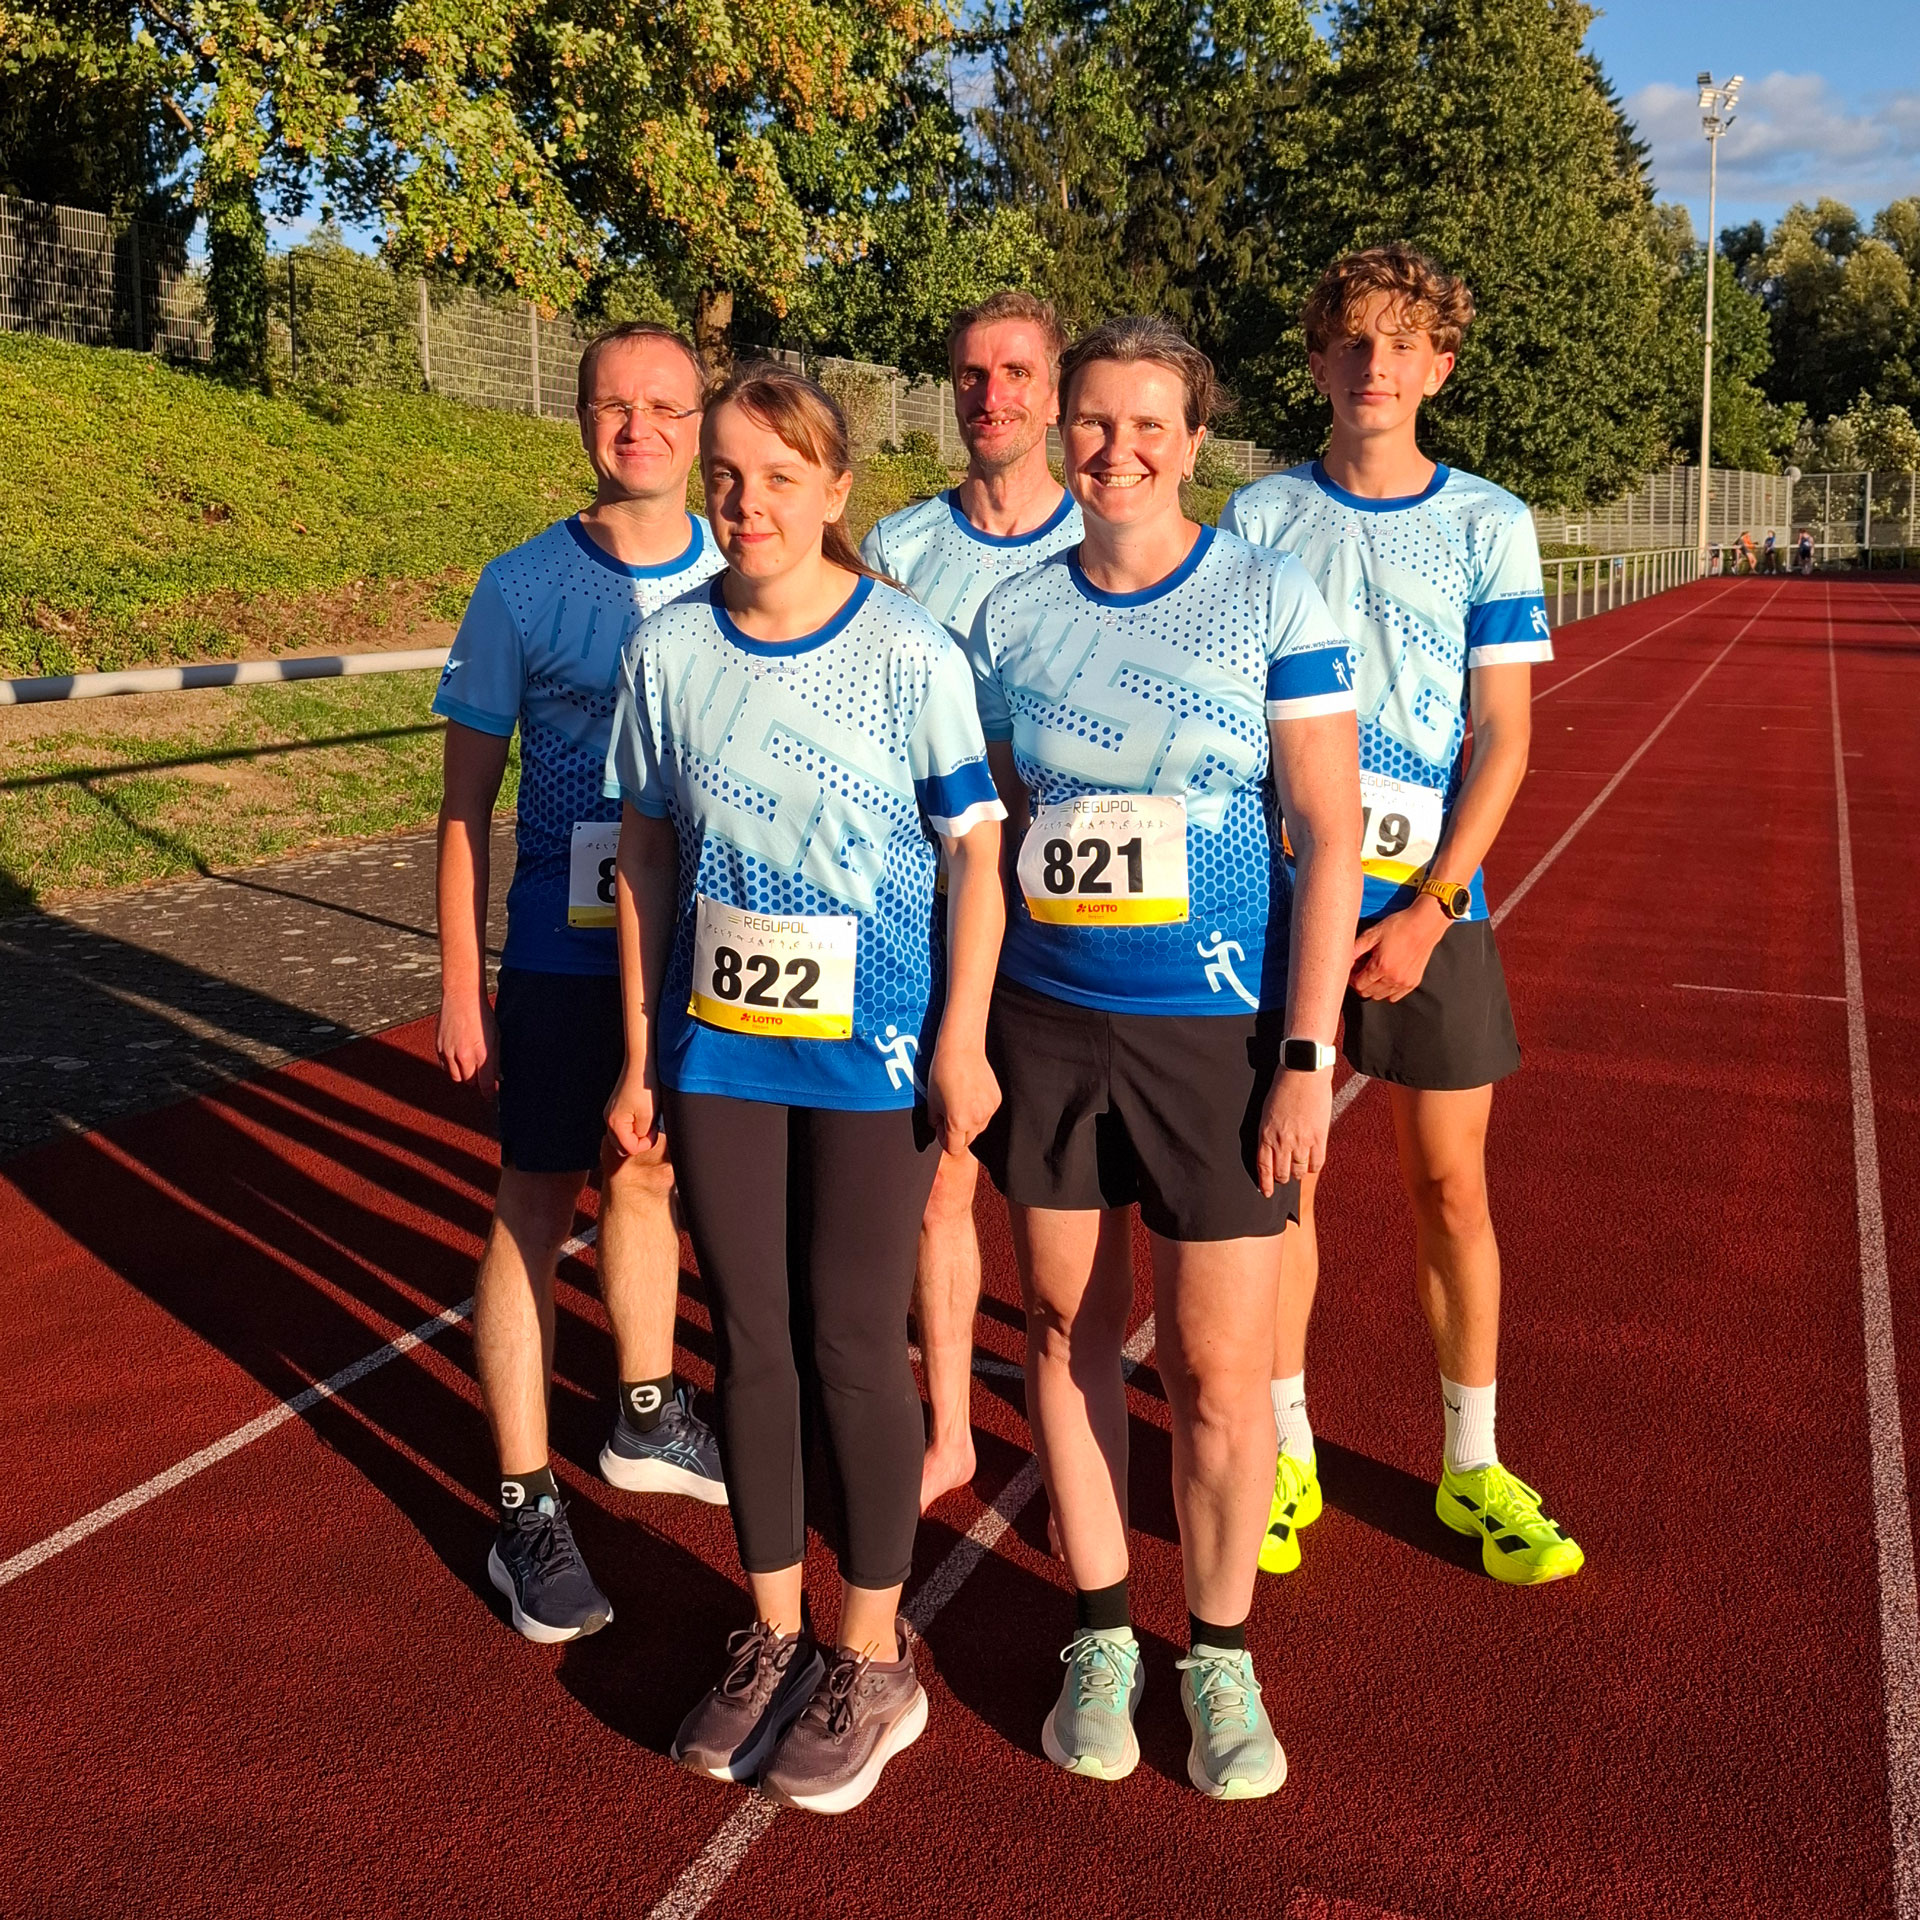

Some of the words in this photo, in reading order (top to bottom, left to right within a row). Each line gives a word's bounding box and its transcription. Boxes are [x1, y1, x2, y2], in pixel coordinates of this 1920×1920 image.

[1360, 774, 1405, 793] EGUPOL
[1073, 800, 1138, 814] REGUPOL
[1043, 837, 1143, 895] 821
[1088, 904, 1118, 913] LOTTO
[743, 916, 809, 934] REGUPOL
[712, 945, 821, 1009] 822
[752, 1015, 783, 1025] LOTTO
